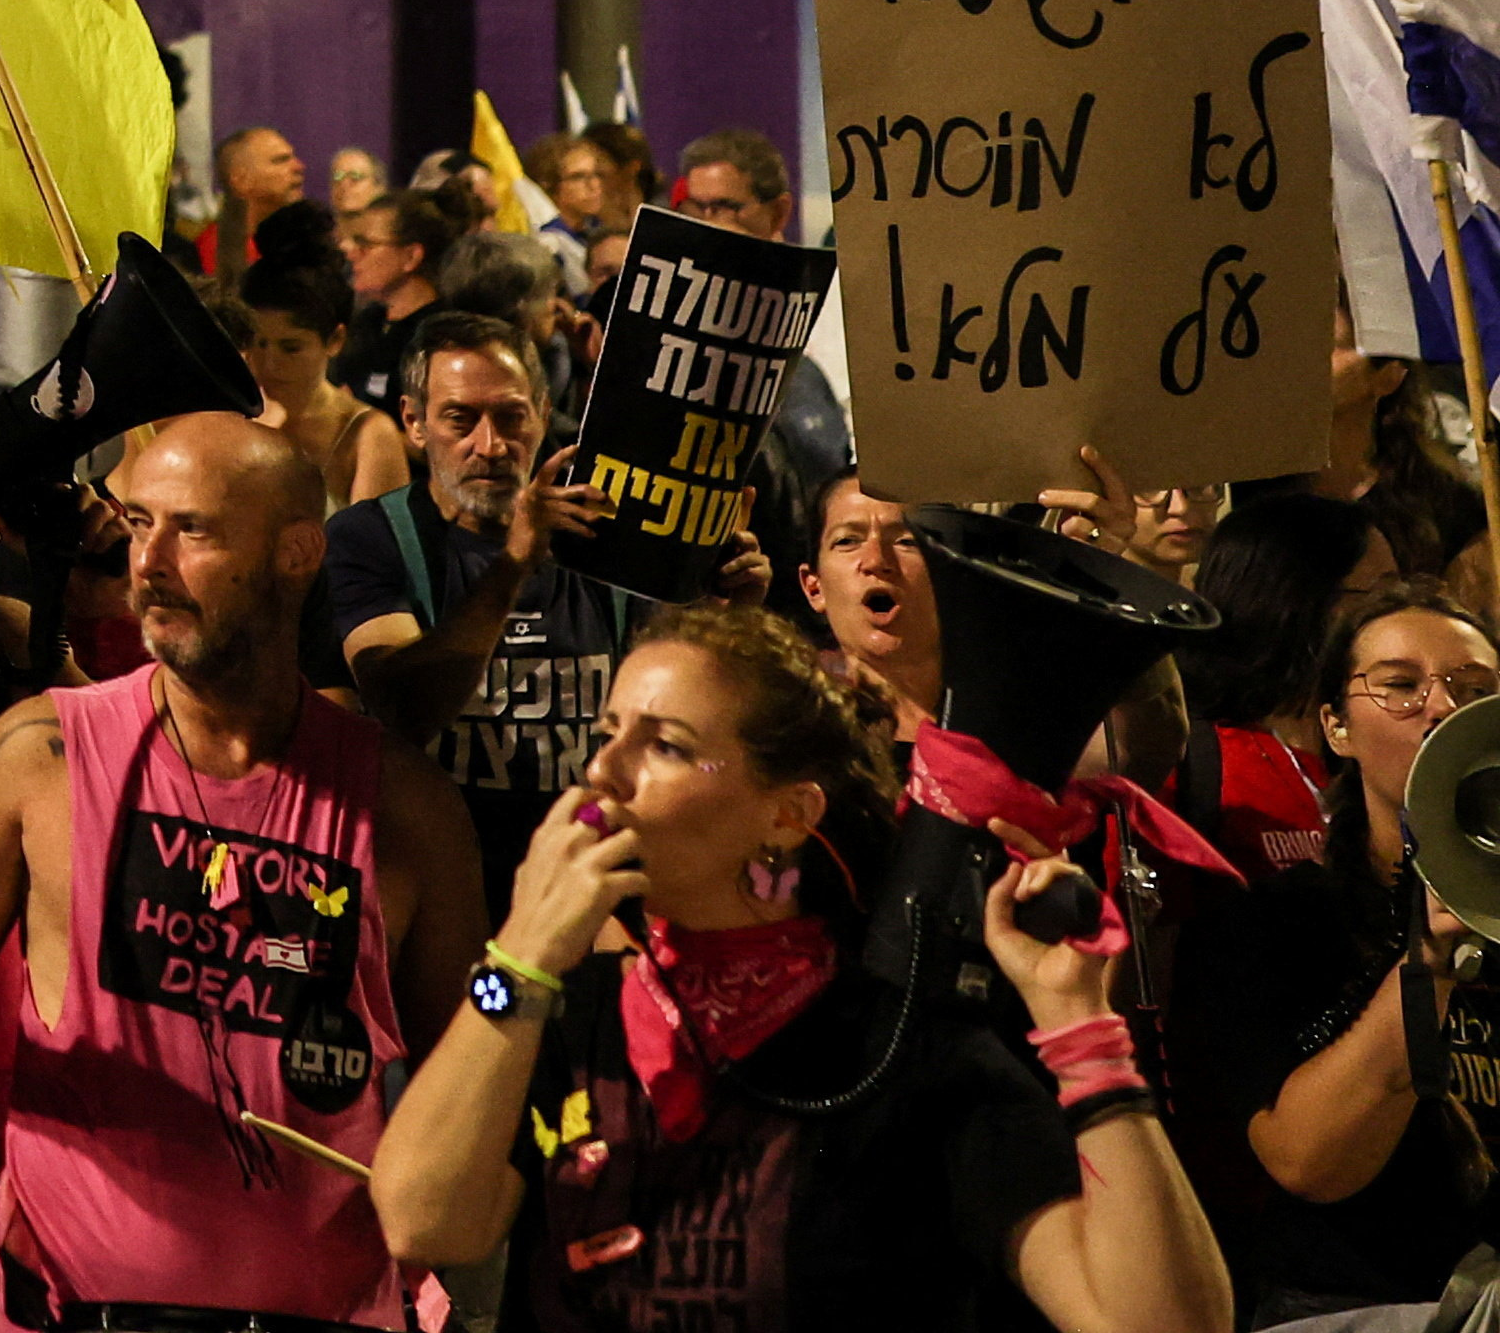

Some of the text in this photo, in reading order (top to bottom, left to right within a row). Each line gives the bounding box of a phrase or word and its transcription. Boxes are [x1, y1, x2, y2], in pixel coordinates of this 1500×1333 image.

[1188, 31, 1310, 212] לא
[627, 253, 820, 350] הממשלה
[887, 223, 1266, 396] על מלא!
[645, 332, 787, 416] הורגת
[668, 410, 751, 481] את
[159, 954, 284, 1024] DEAL
